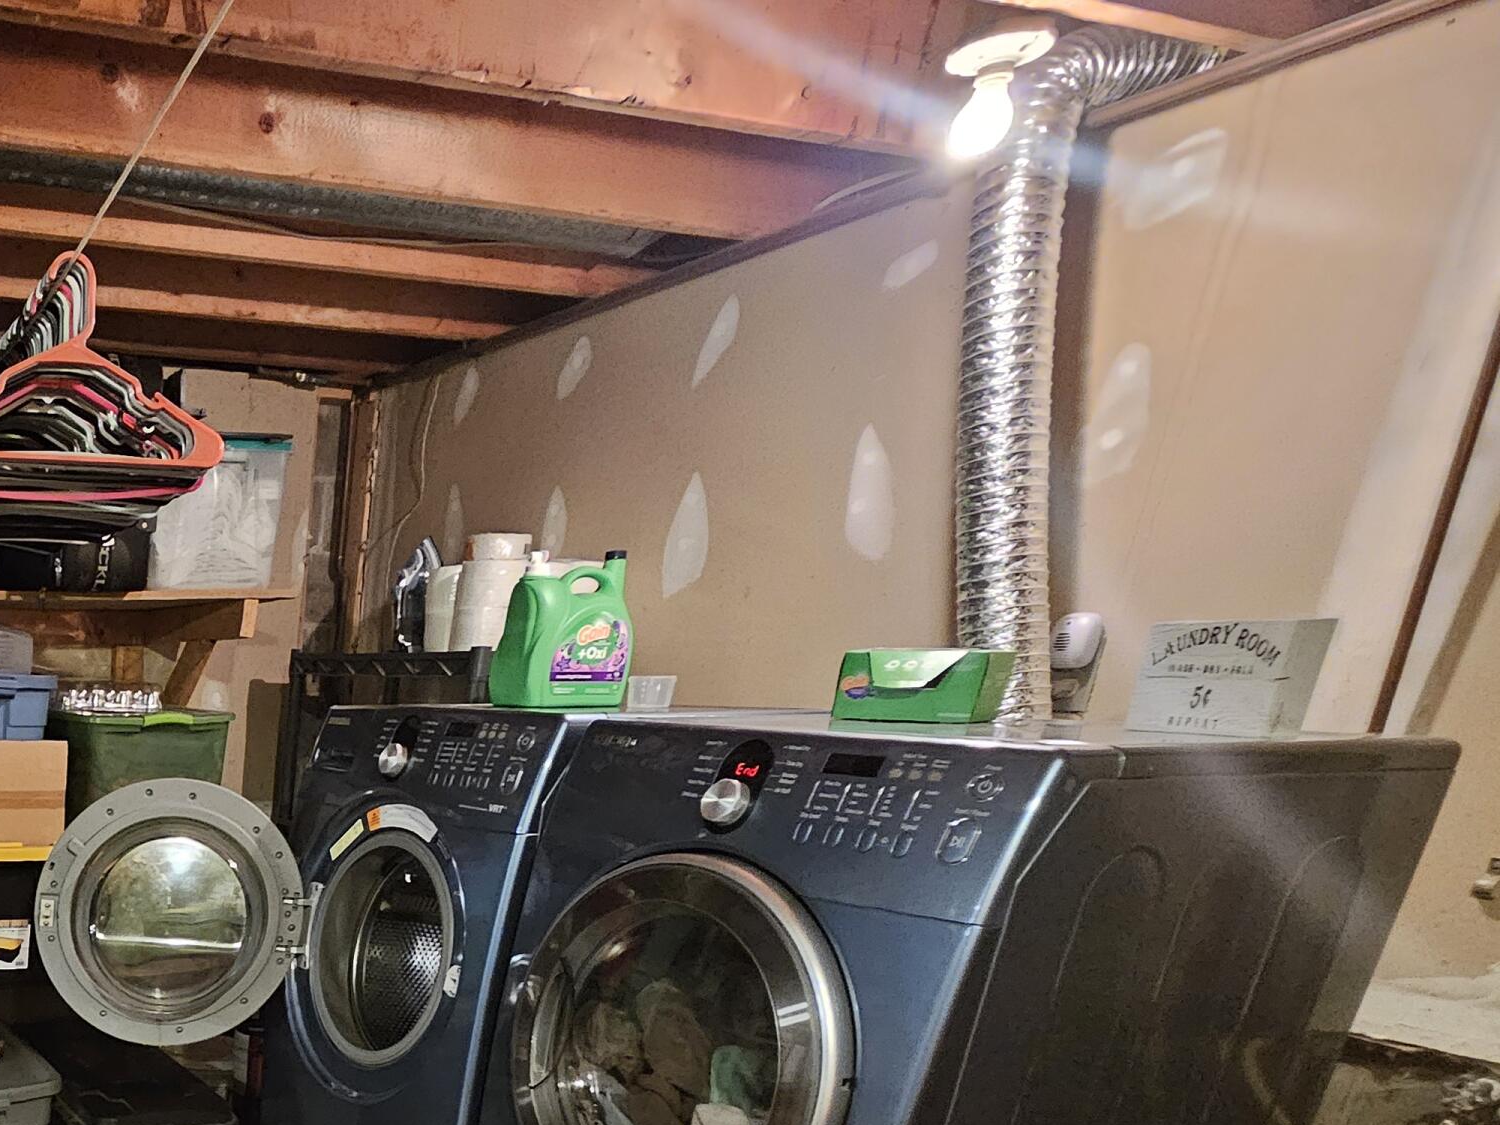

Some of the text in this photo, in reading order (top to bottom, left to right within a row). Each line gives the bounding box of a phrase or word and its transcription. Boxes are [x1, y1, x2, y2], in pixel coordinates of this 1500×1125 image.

[577, 624, 612, 646] Gain
[1152, 622, 1281, 668] LAUNDRY ROOM
[735, 763, 760, 777] End
